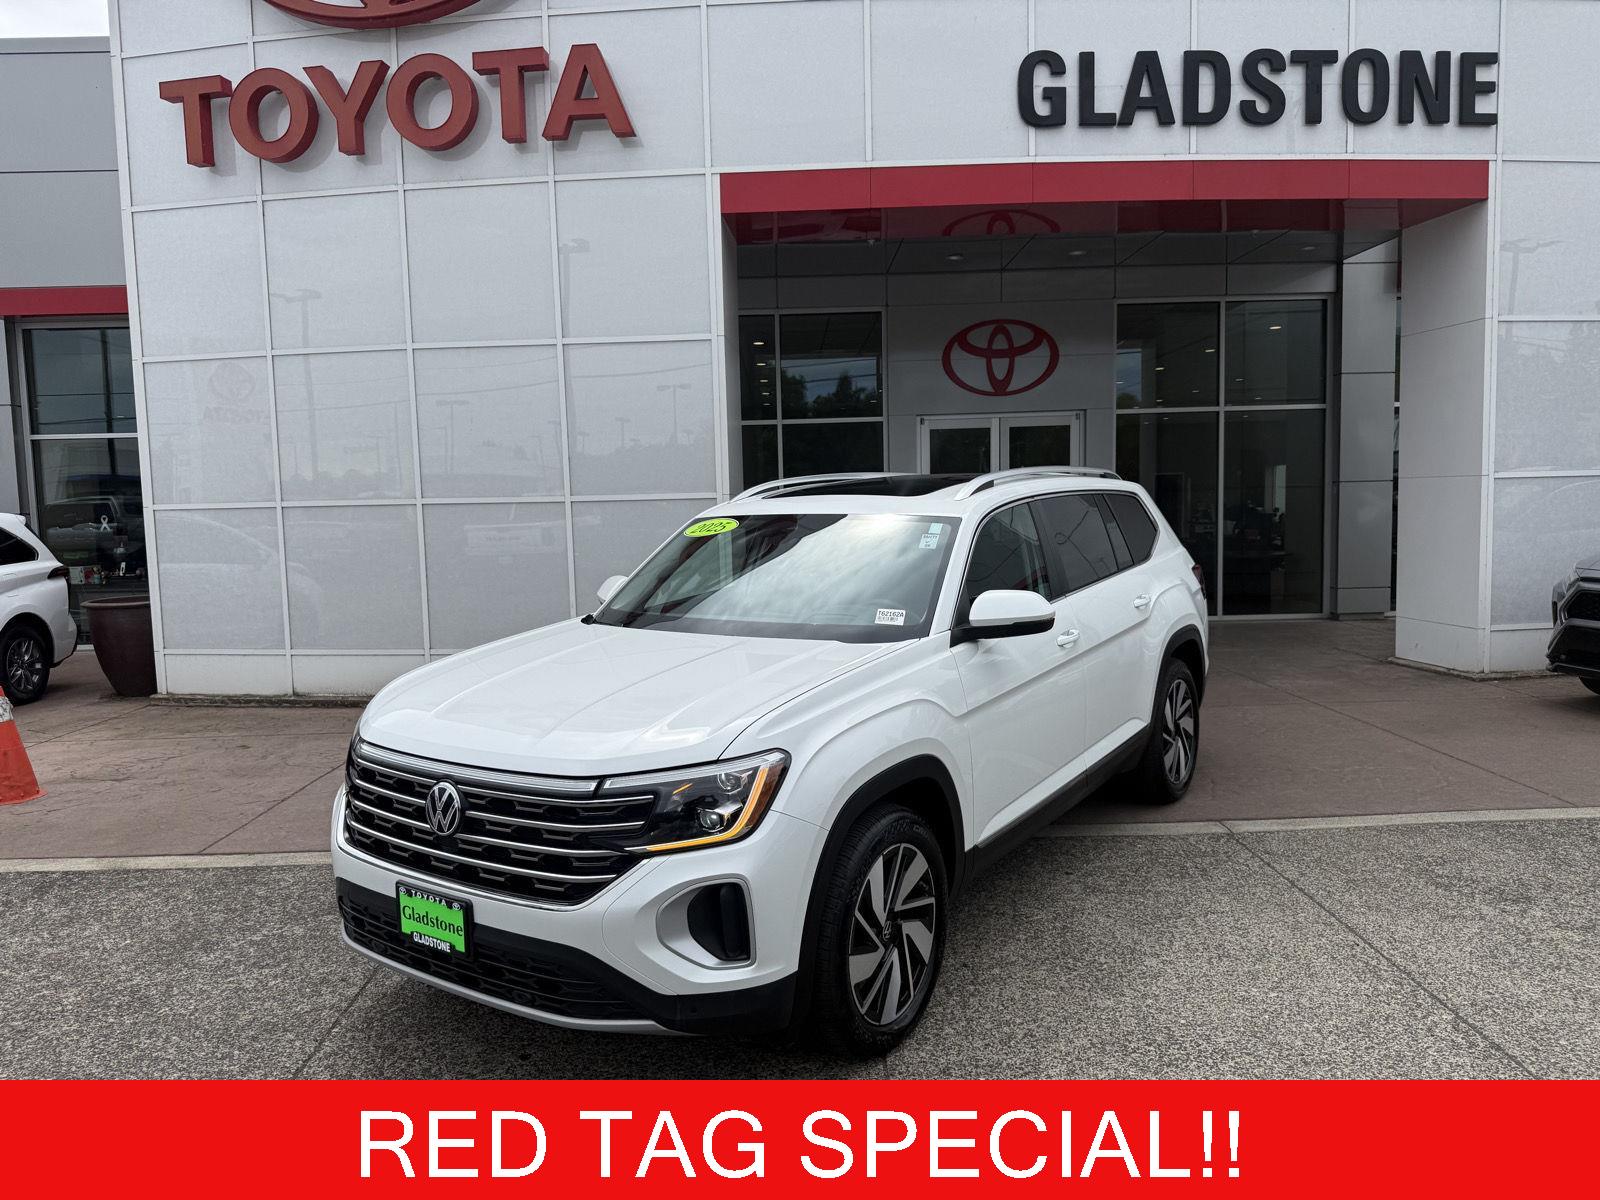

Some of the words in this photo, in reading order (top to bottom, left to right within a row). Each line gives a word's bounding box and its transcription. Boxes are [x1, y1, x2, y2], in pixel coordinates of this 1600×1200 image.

[1017, 48, 1499, 129] GLADSTONE
[159, 43, 636, 167] TOYOTA
[690, 521, 731, 534] 2025
[411, 889, 447, 906] TOYOTA
[402, 905, 464, 936] Gladstone
[413, 932, 451, 952] GLADSTONE
